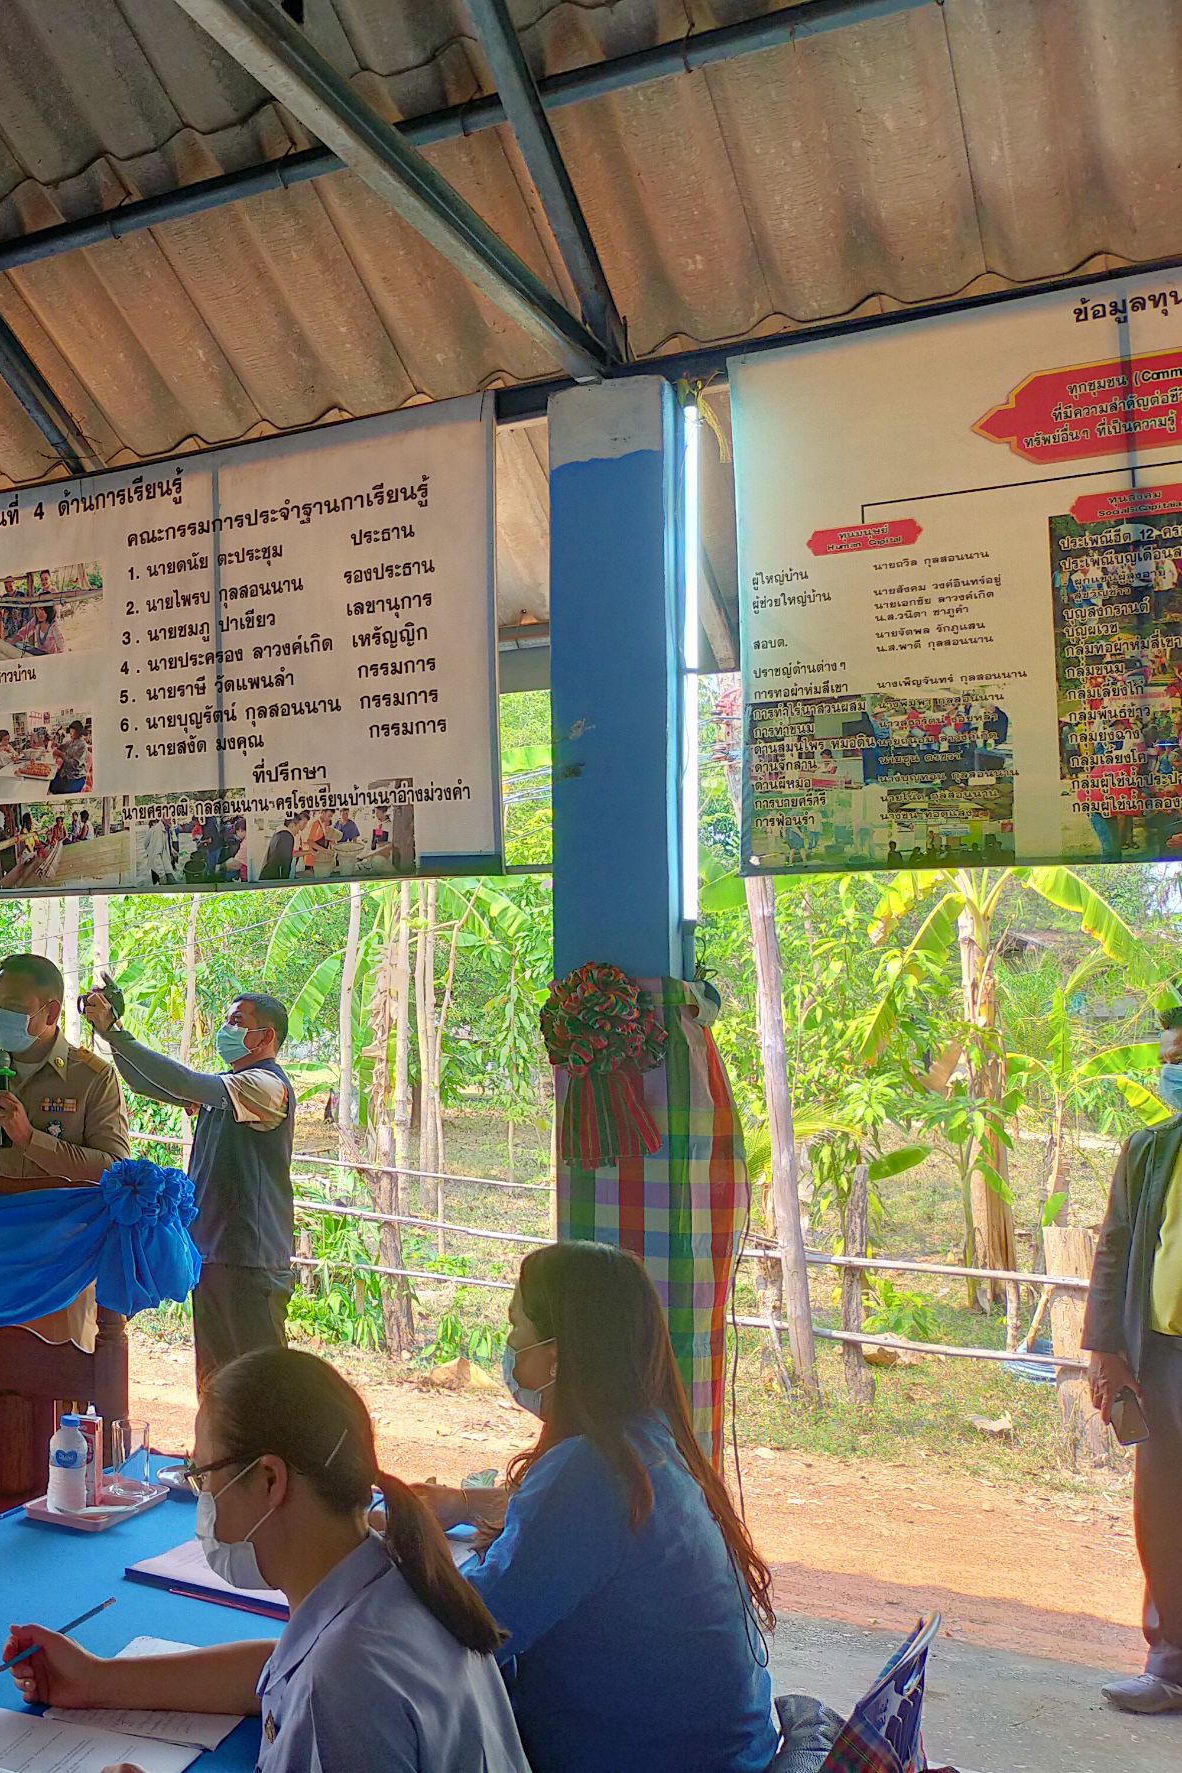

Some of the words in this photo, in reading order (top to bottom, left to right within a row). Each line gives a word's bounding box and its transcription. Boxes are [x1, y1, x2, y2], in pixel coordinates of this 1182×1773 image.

[1096, 411, 1175, 437] ที่เป็นความรู้
[34, 503, 44, 520] 4
[57, 467, 183, 517] ด้านการเรียนรู้
[128, 566, 140, 580] 1.
[147, 551, 209, 578] นายดนัย
[217, 543, 283, 568] ตะประชุม
[351, 522, 415, 547] ประธาน
[1140, 529, 1154, 540] 12
[126, 601, 139, 615] 2.
[146, 589, 211, 614] นายไพรบ
[218, 577, 304, 610] กุลสอนนาน
[344, 558, 435, 585] รองประธาน
[752, 568, 808, 591] ผู้ใหญ่บ้าน
[147, 621, 210, 643] นายชมภู
[219, 611, 276, 634] ปาเขียว
[346, 591, 433, 618] เลขานุการ
[753, 589, 831, 614] ผู้ช่วยใหญ่บ้าน
[147, 646, 243, 673] นายประครอง
[253, 633, 333, 659] ลาวงค์เกิด
[352, 621, 428, 649] เหรัญญิก
[146, 677, 207, 702] นายราษี
[216, 669, 295, 694] วัดแพนลำ
[357, 656, 436, 679] กรรมการ
[1066, 660, 1124, 683] กลุ่มขนม
[146, 703, 237, 732] นายบุญรัตน์
[246, 698, 341, 722] กุลสอนนาน
[359, 688, 438, 710] กรรมการ
[125, 744, 138, 759] 7.
[146, 735, 207, 757] นายสงัด
[216, 734, 264, 757] มงคุณ
[369, 718, 447, 739] กรรมการ
[253, 757, 326, 784] ที่ปรึกษา
